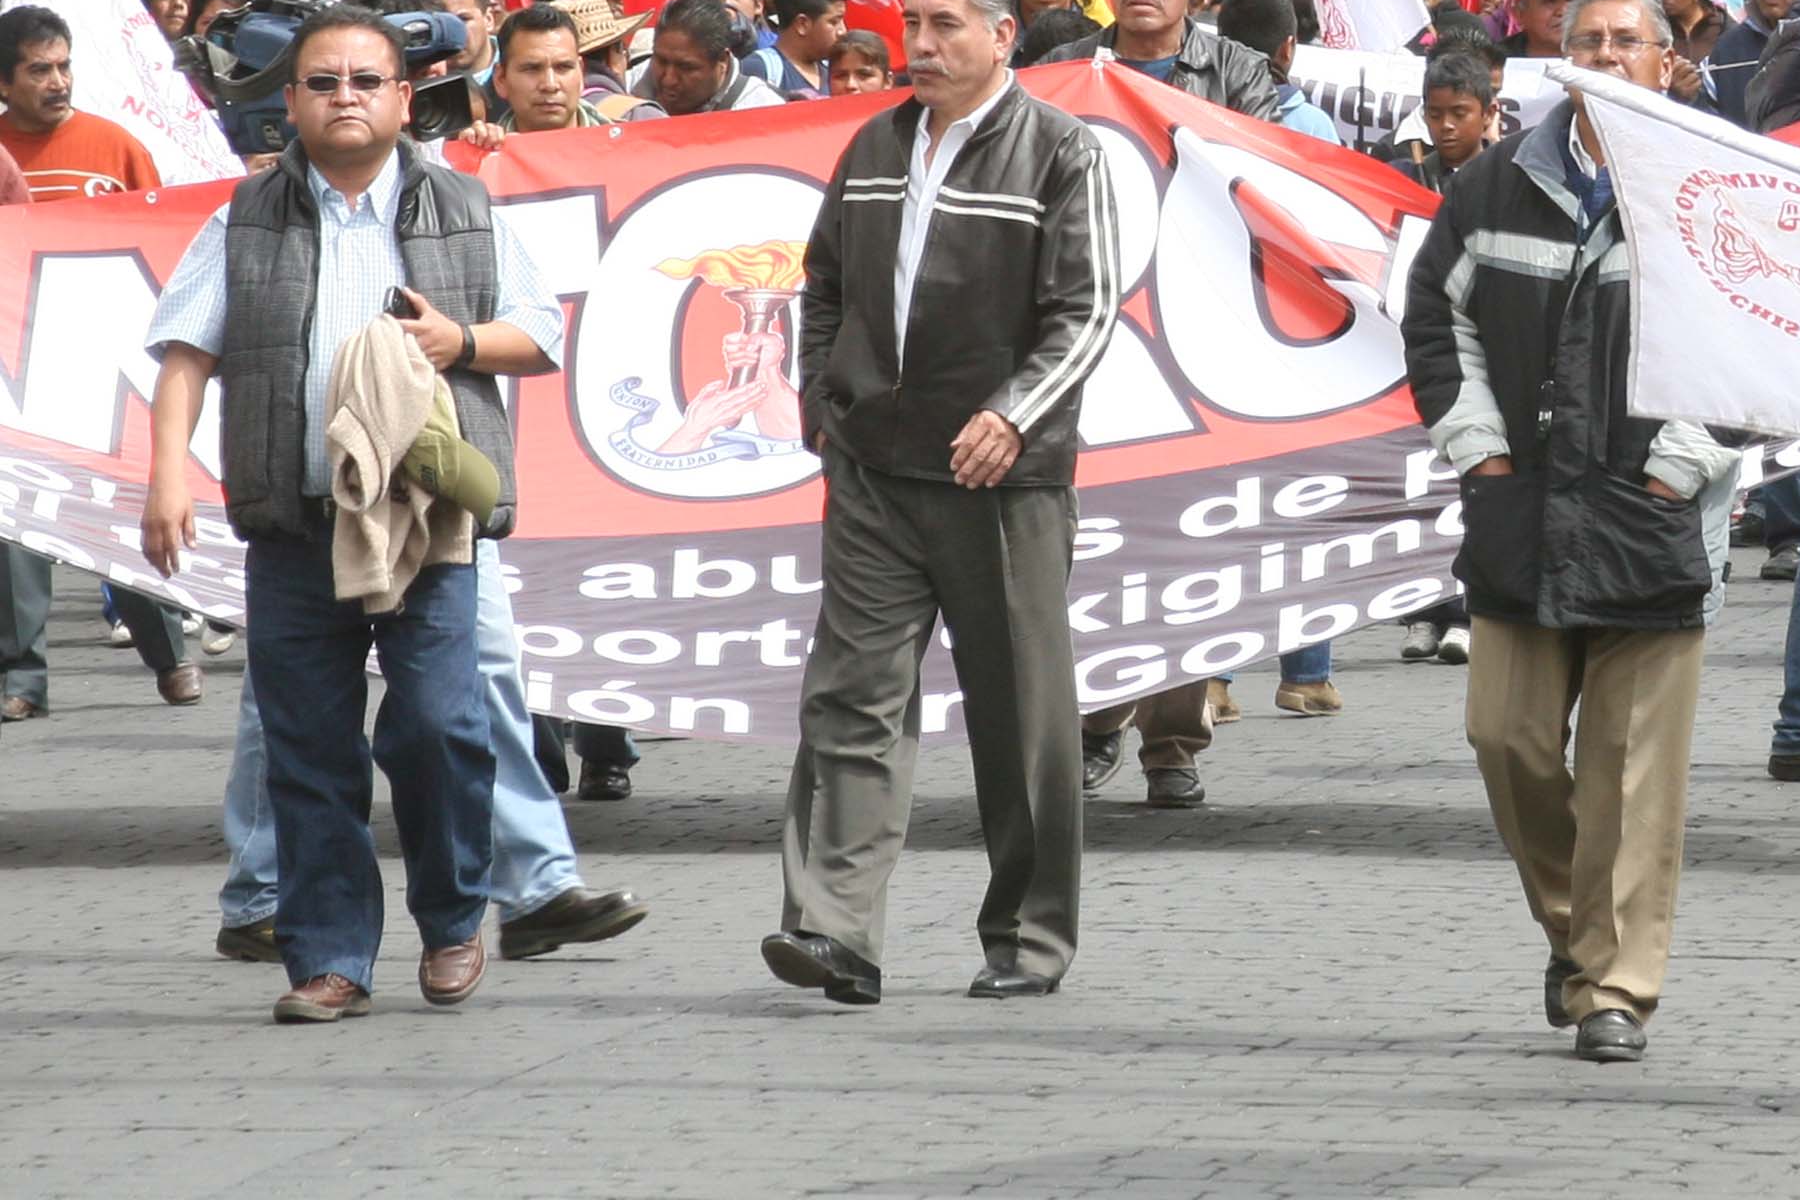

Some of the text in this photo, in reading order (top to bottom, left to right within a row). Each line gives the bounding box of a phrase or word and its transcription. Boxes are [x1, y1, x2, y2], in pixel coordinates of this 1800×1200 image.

[603, 384, 651, 410] UNION
[605, 437, 719, 469] FRATERNIDAD
[1178, 474, 1351, 539] de
[1067, 502, 1465, 633] xigim
[525, 669, 751, 735] ión
[1071, 575, 1466, 702] Gobe
